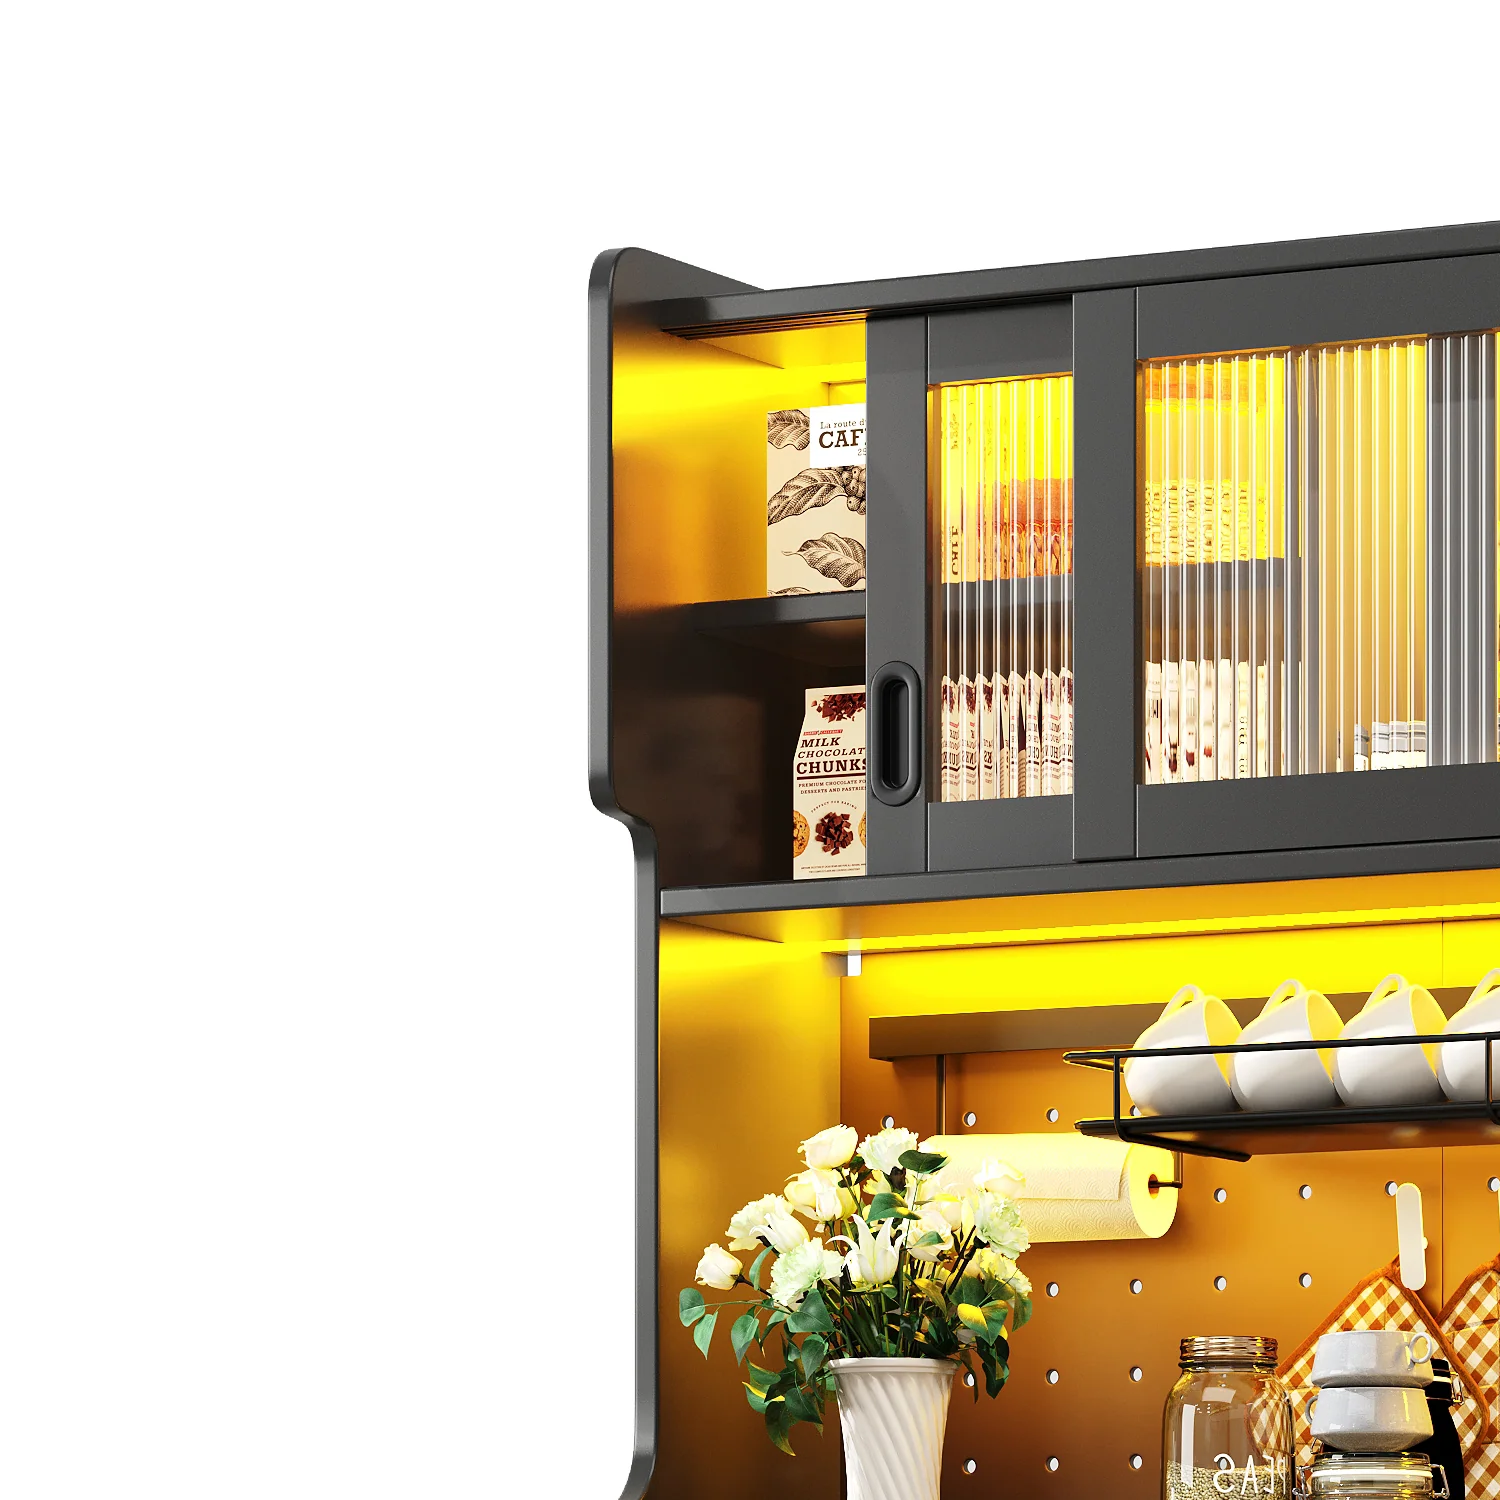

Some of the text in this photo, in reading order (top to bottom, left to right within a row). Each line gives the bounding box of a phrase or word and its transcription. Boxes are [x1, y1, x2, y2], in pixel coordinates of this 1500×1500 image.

[820, 421, 831, 429] La
[834, 420, 857, 429] route
[818, 428, 867, 449] CAF
[800, 736, 841, 748] MILK
